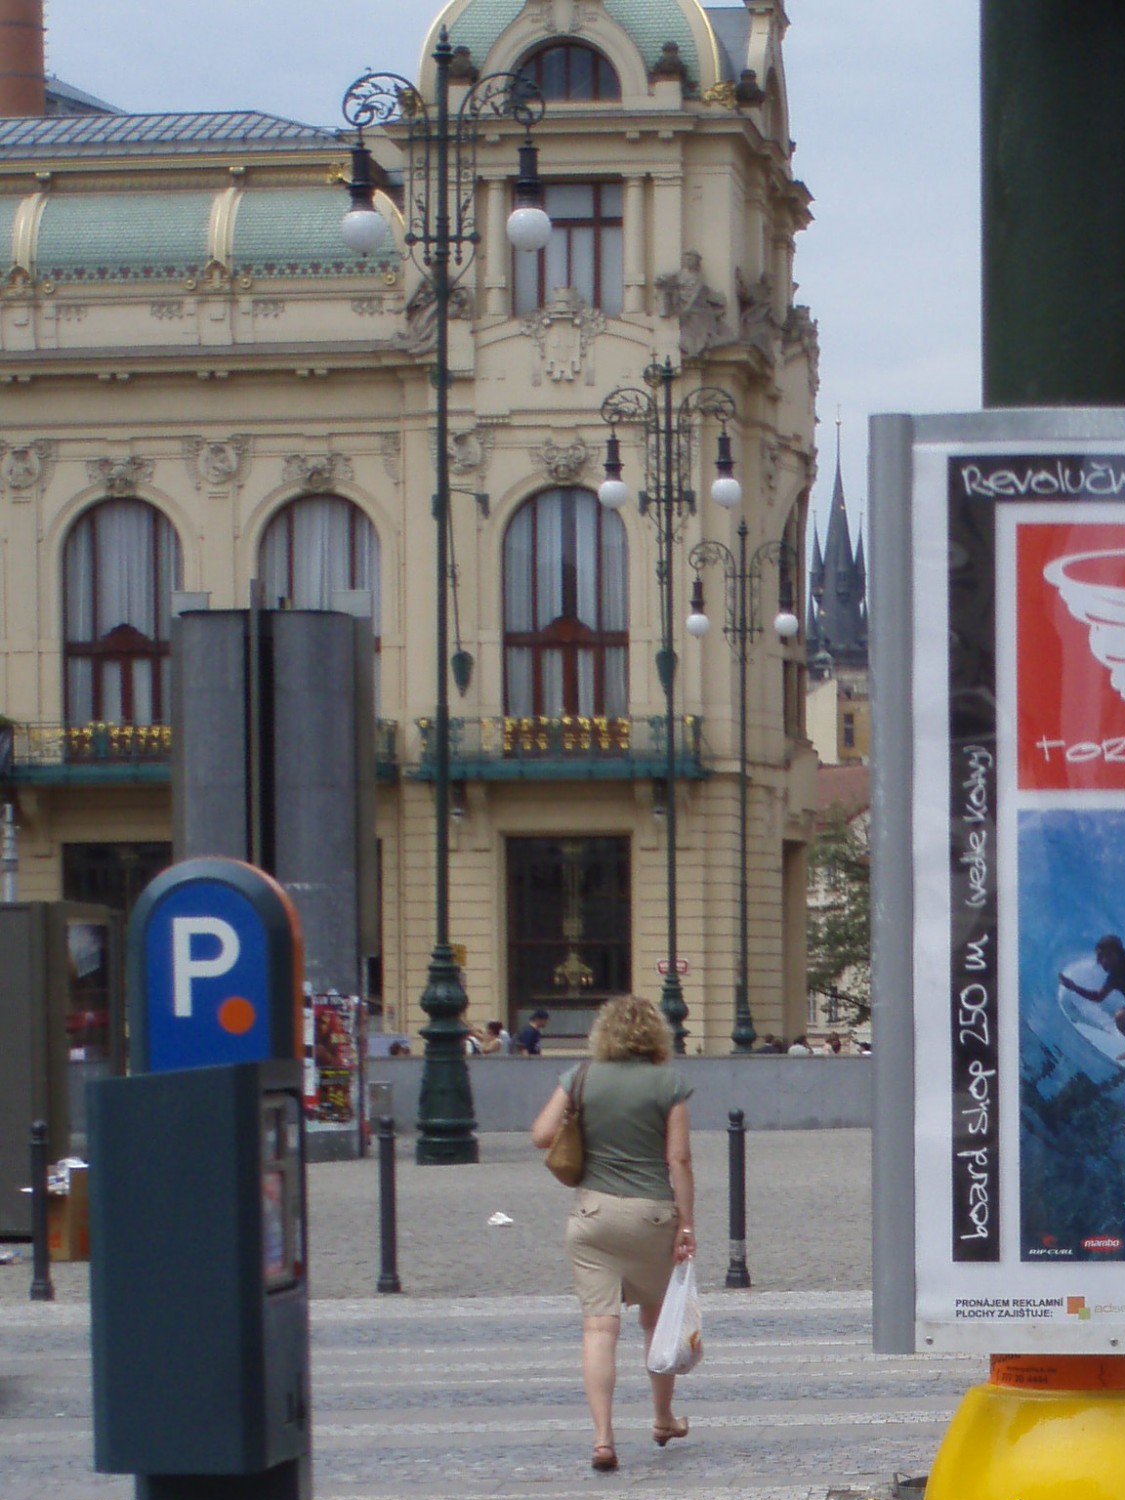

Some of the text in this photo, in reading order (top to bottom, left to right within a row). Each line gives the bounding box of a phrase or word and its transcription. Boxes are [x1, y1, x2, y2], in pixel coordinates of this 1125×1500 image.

[172, 916, 241, 1017] P
[964, 933, 989, 971] m
[959, 983, 990, 1045] 250
[962, 1060, 996, 1134] shop
[957, 1147, 989, 1240] board
[1084, 1239, 1120, 1248] mambo
[955, 1309, 997, 1318] PLOCHY
